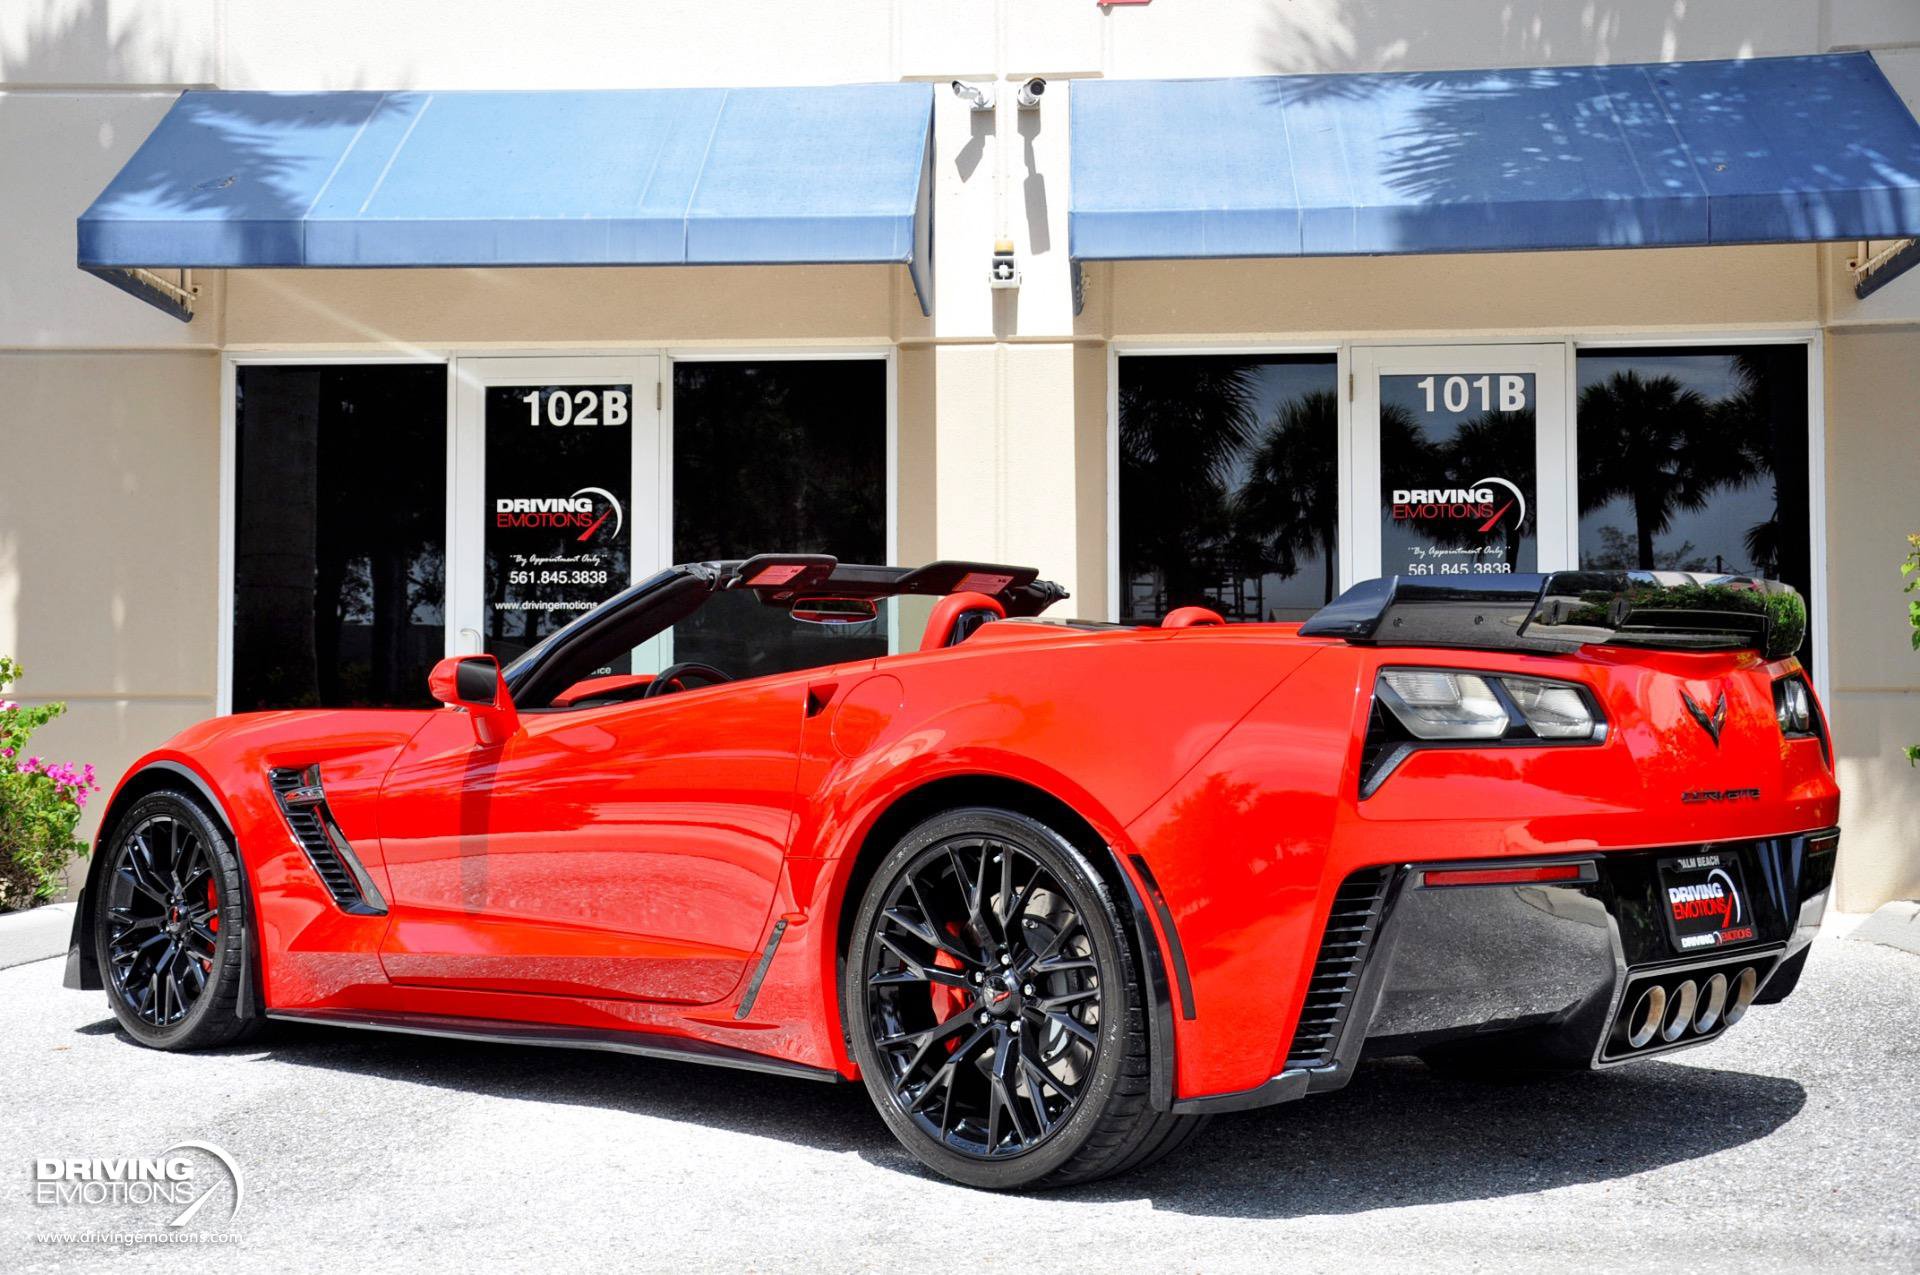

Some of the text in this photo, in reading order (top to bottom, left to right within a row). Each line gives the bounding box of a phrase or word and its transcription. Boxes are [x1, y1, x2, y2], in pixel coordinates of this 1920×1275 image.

[1418, 375, 1526, 412] 101B
[523, 390, 628, 426] 102B
[1393, 489, 1494, 504] DRIVING
[497, 498, 593, 513] DRIVING
[1392, 504, 1494, 519] EMOTIONS
[497, 513, 593, 528] EMOTIONS
[529, 554, 580, 565] Appointment
[1428, 546, 1482, 558] Appointment
[1408, 563, 1512, 576] 5618453838
[509, 571, 607, 584] 561.845.3838
[1697, 855, 1720, 867] BEACH
[1668, 882, 1724, 904] DRIVING
[1672, 897, 1726, 920] EMOTIONS
[1681, 933, 1716, 948] DRIVING
